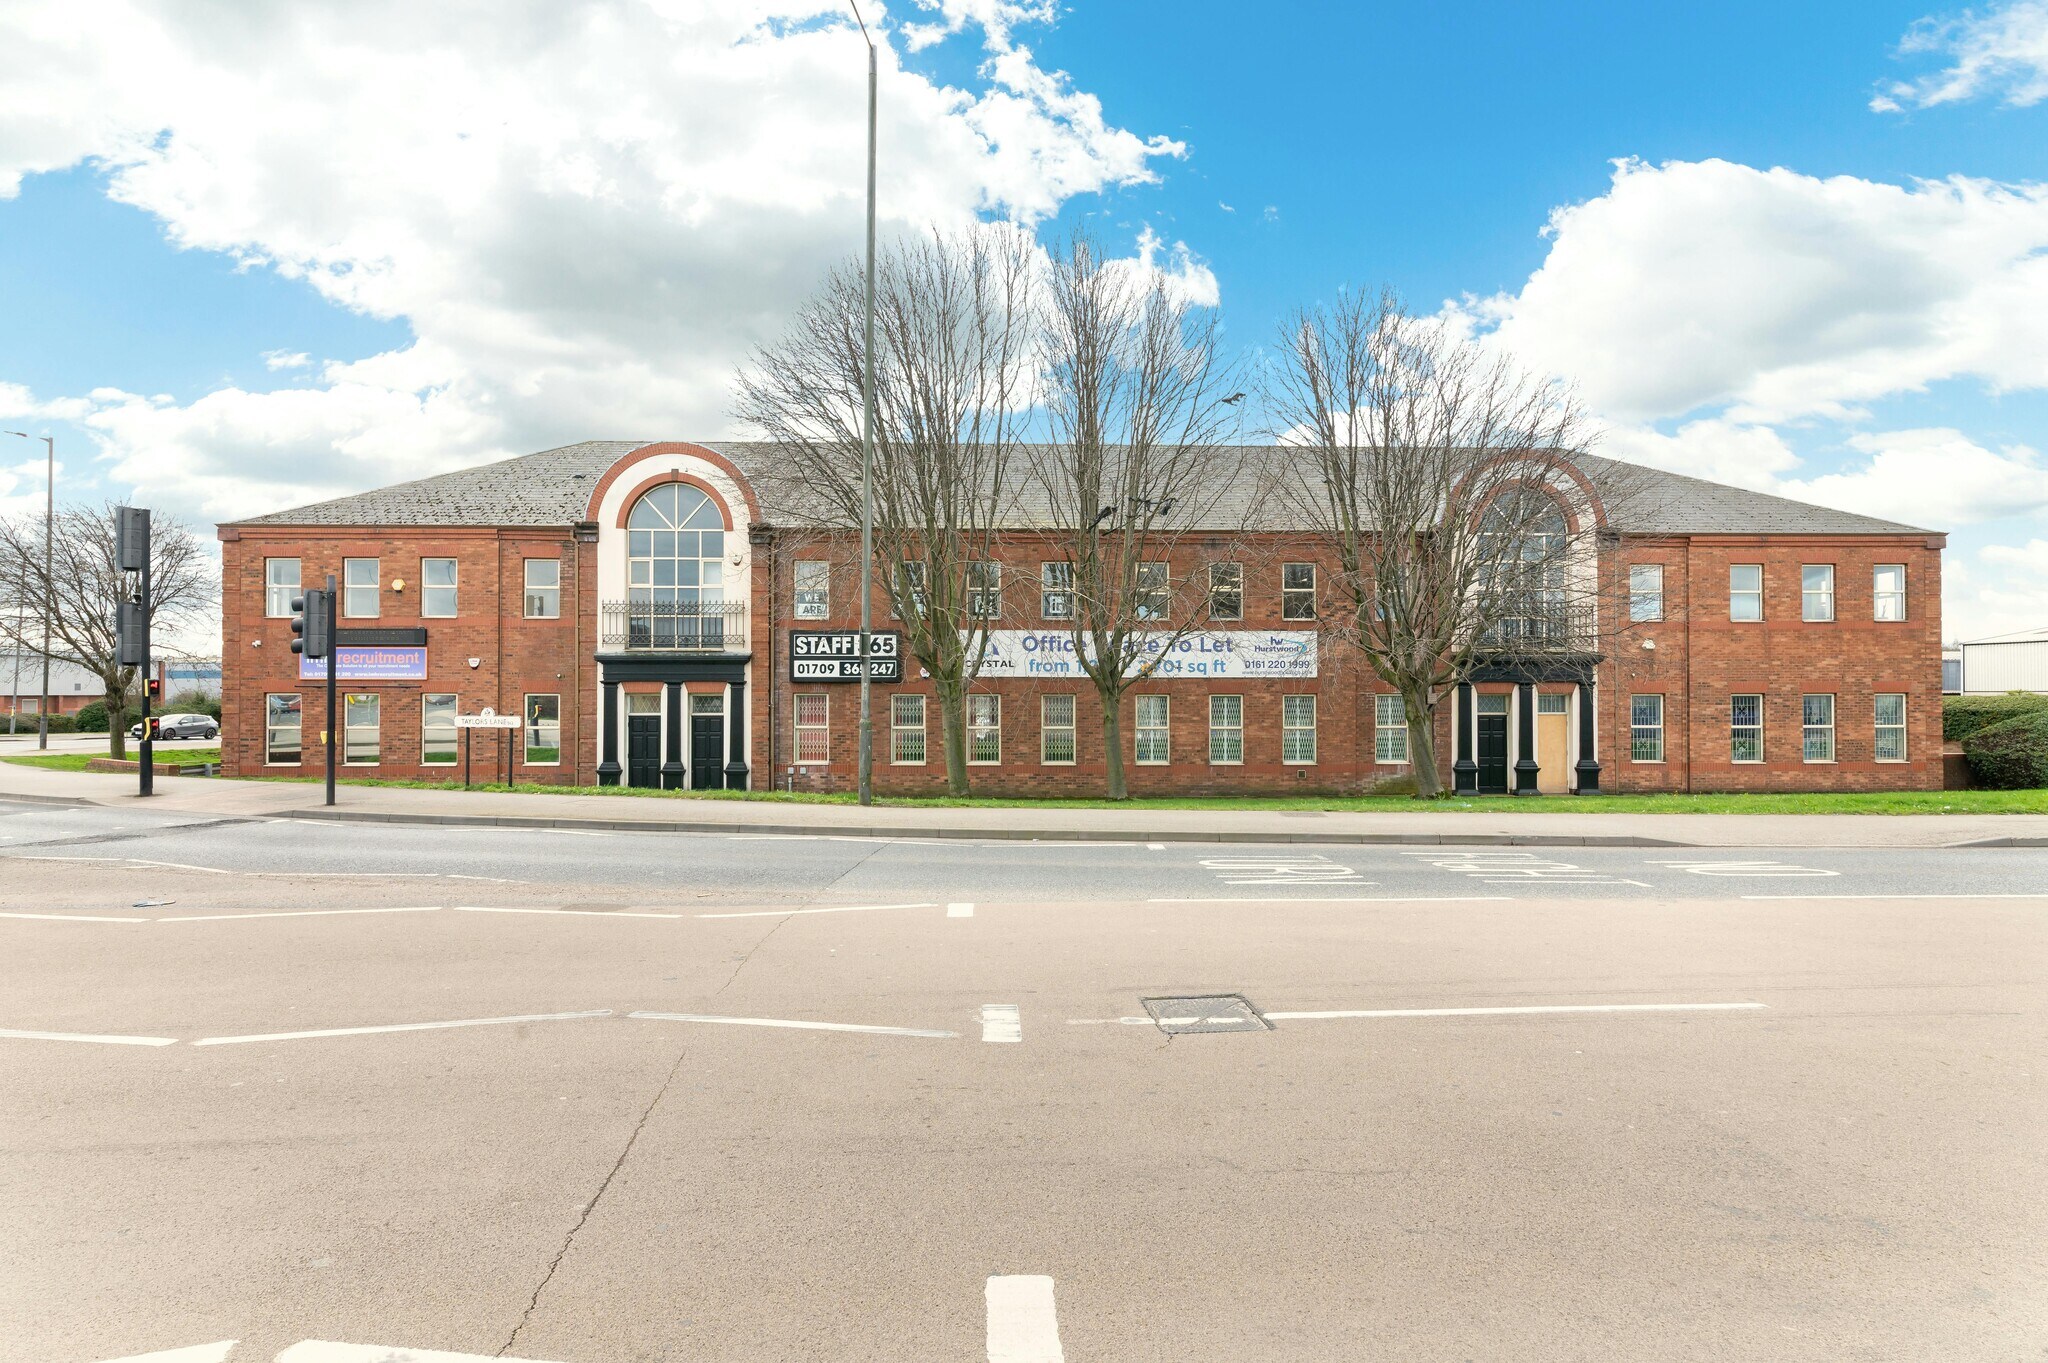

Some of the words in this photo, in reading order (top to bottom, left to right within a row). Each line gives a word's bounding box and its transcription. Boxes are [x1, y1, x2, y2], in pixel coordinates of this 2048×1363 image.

[804, 593, 820, 602] WE
[802, 605, 822, 614] ARE
[796, 636, 851, 654] STAFF
[1200, 637, 1234, 652] Let
[337, 652, 419, 664] recruitment
[798, 663, 835, 674] 01709
[844, 663, 862, 675] 36
[871, 663, 894, 675] 247
[1029, 658, 1069, 672] from
[1188, 662, 1207, 675] sq
[1213, 659, 1226, 673] ft
[1245, 660, 1265, 669] 0161
[1268, 660, 1286, 669] 220
